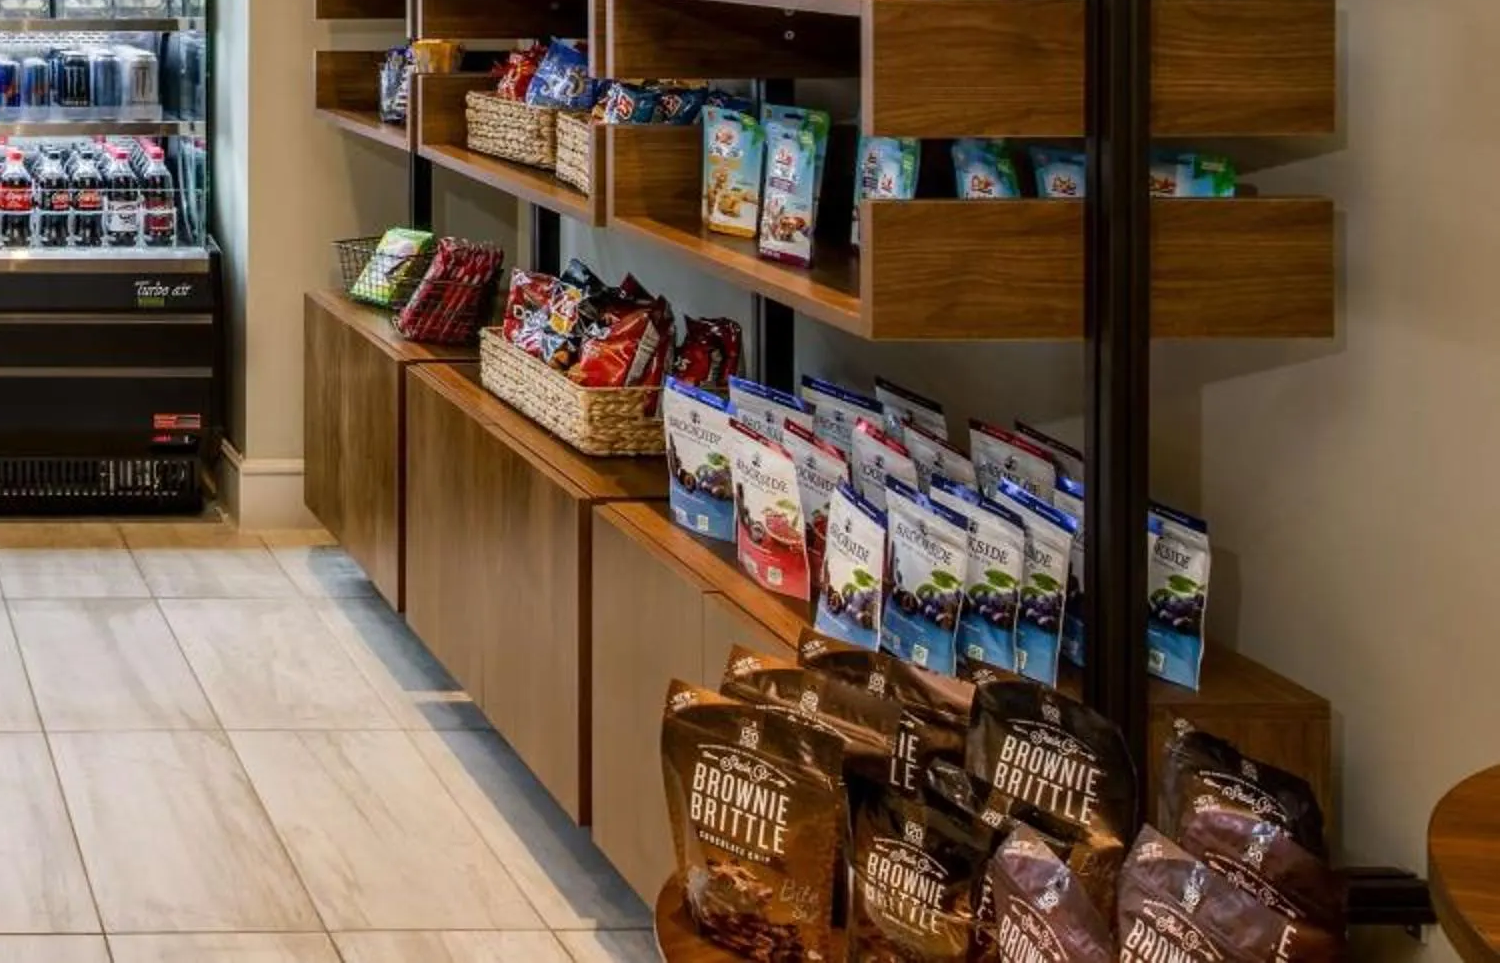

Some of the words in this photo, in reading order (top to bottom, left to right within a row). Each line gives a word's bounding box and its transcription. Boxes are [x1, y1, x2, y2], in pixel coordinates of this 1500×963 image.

[692, 761, 792, 826] BROWNIE
[993, 761, 1101, 826] BRITTLE
[1001, 734, 1102, 797] BROWNIE
[690, 790, 791, 856] BRITTLE
[864, 882, 942, 935] BRITTLE
[866, 851, 947, 910] BROWNIE
